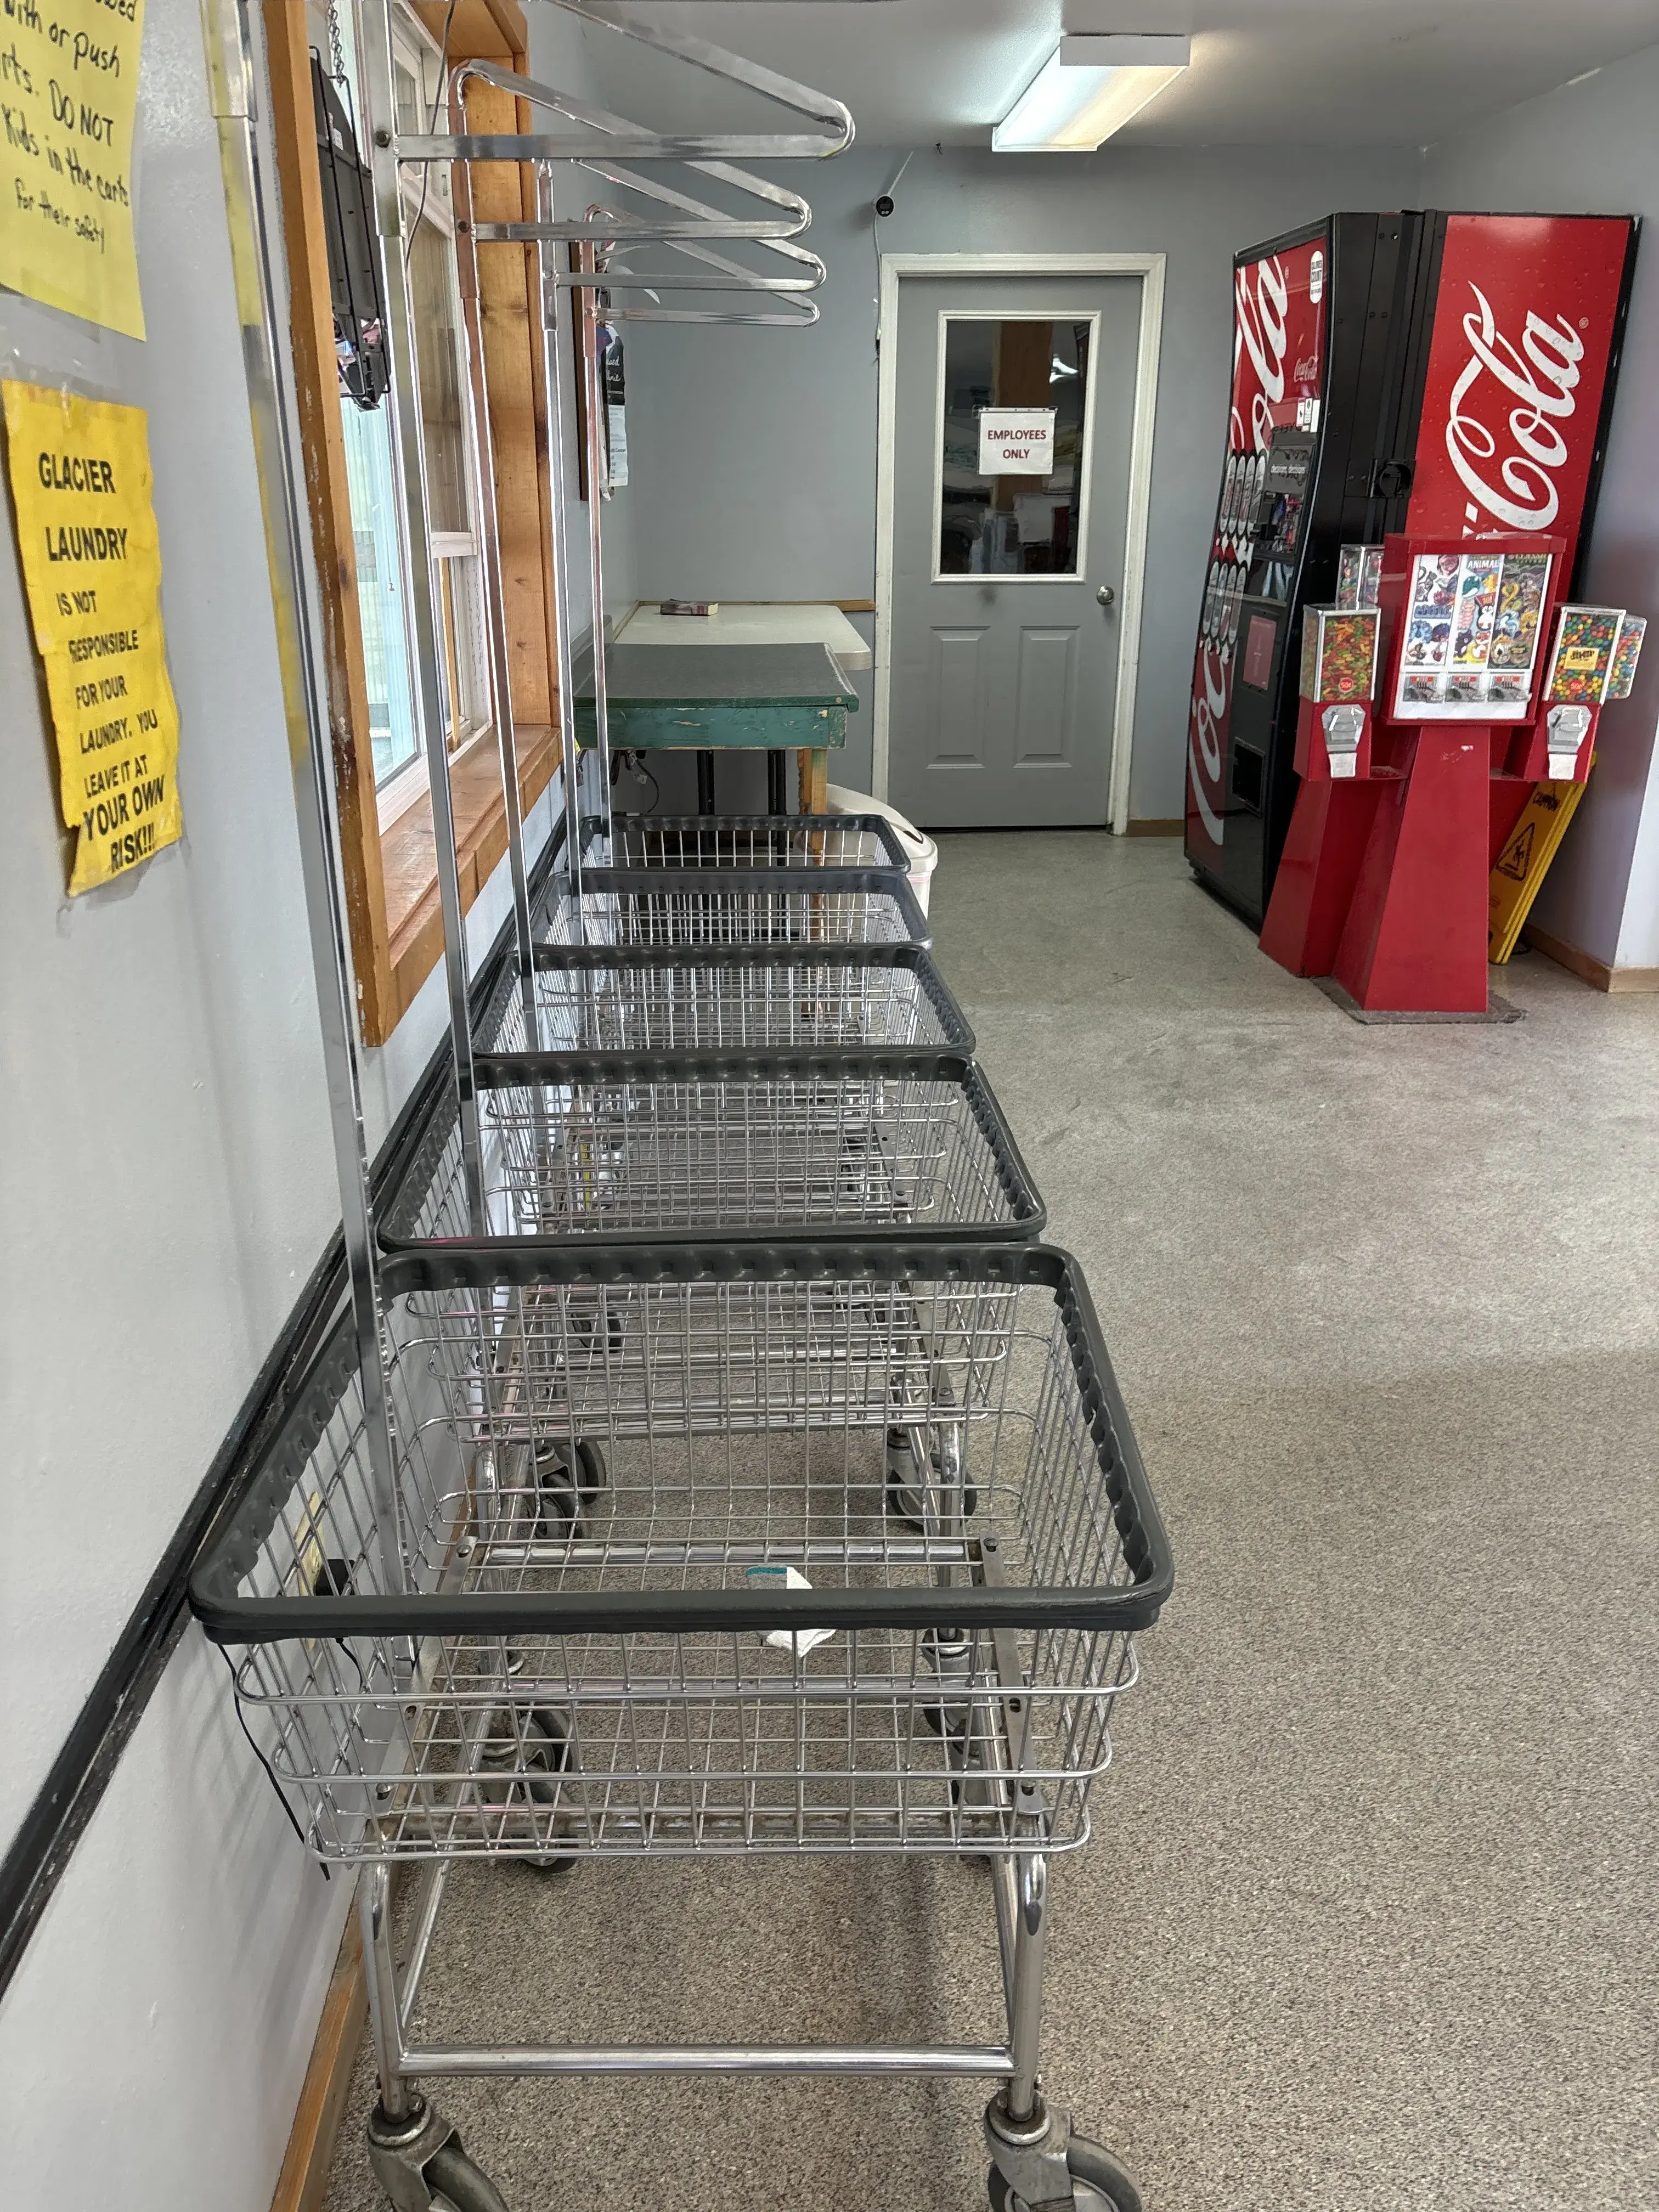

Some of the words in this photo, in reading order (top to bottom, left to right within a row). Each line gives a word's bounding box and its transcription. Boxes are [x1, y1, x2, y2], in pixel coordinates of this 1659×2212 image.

[48, 22, 70, 48] or
[49, 79, 75, 129] DO
[80, 103, 114, 147] NOT
[65, 146, 93, 192] the
[987, 430, 1047, 441] EMPLOYEES
[1002, 448, 1030, 459] ONLY
[38, 452, 117, 494] GLACIER
[45, 526, 128, 562] LAUNDRY
[56, 591, 72, 616] IS
[71, 590, 97, 614] NOT
[68, 629, 139, 664] RESPONSIBLE
[75, 682, 99, 710] FOR
[98, 675, 128, 702] YOUR
[80, 717, 133, 754] LAUNDRY.
[137, 708, 159, 734] YOU
[83, 765, 119, 799] LEAVE
[121, 759, 131, 783] IT
[134, 754, 149, 780] AT
[83, 792, 130, 841] YOUR
[132, 774, 165, 816] OWN
[110, 822, 156, 873] RISK!!!
